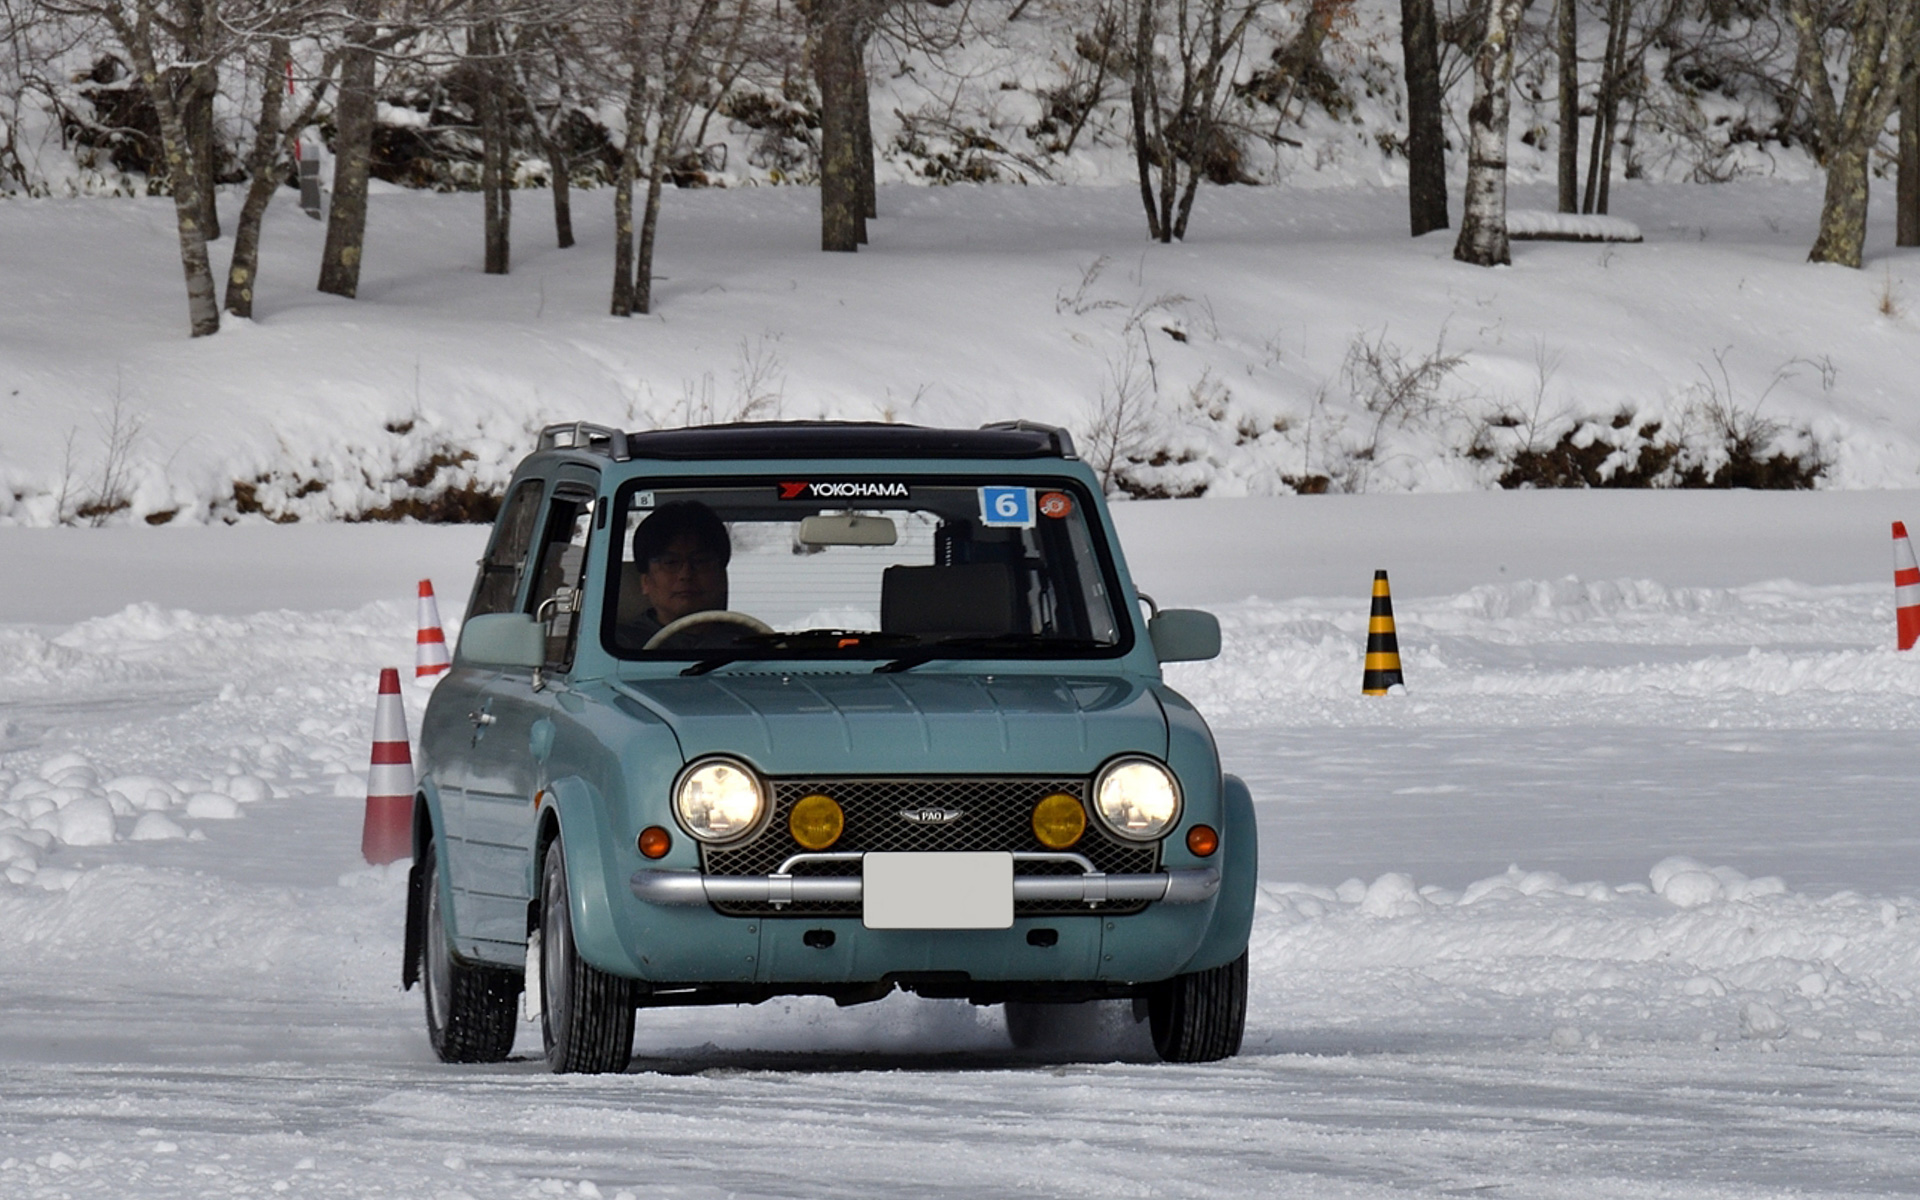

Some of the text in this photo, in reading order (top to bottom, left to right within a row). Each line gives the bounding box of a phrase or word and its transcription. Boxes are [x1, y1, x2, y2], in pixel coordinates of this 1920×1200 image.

[809, 483, 908, 496] YOKOHAMA
[995, 493, 1018, 517] 6
[922, 811, 942, 820] PAO
